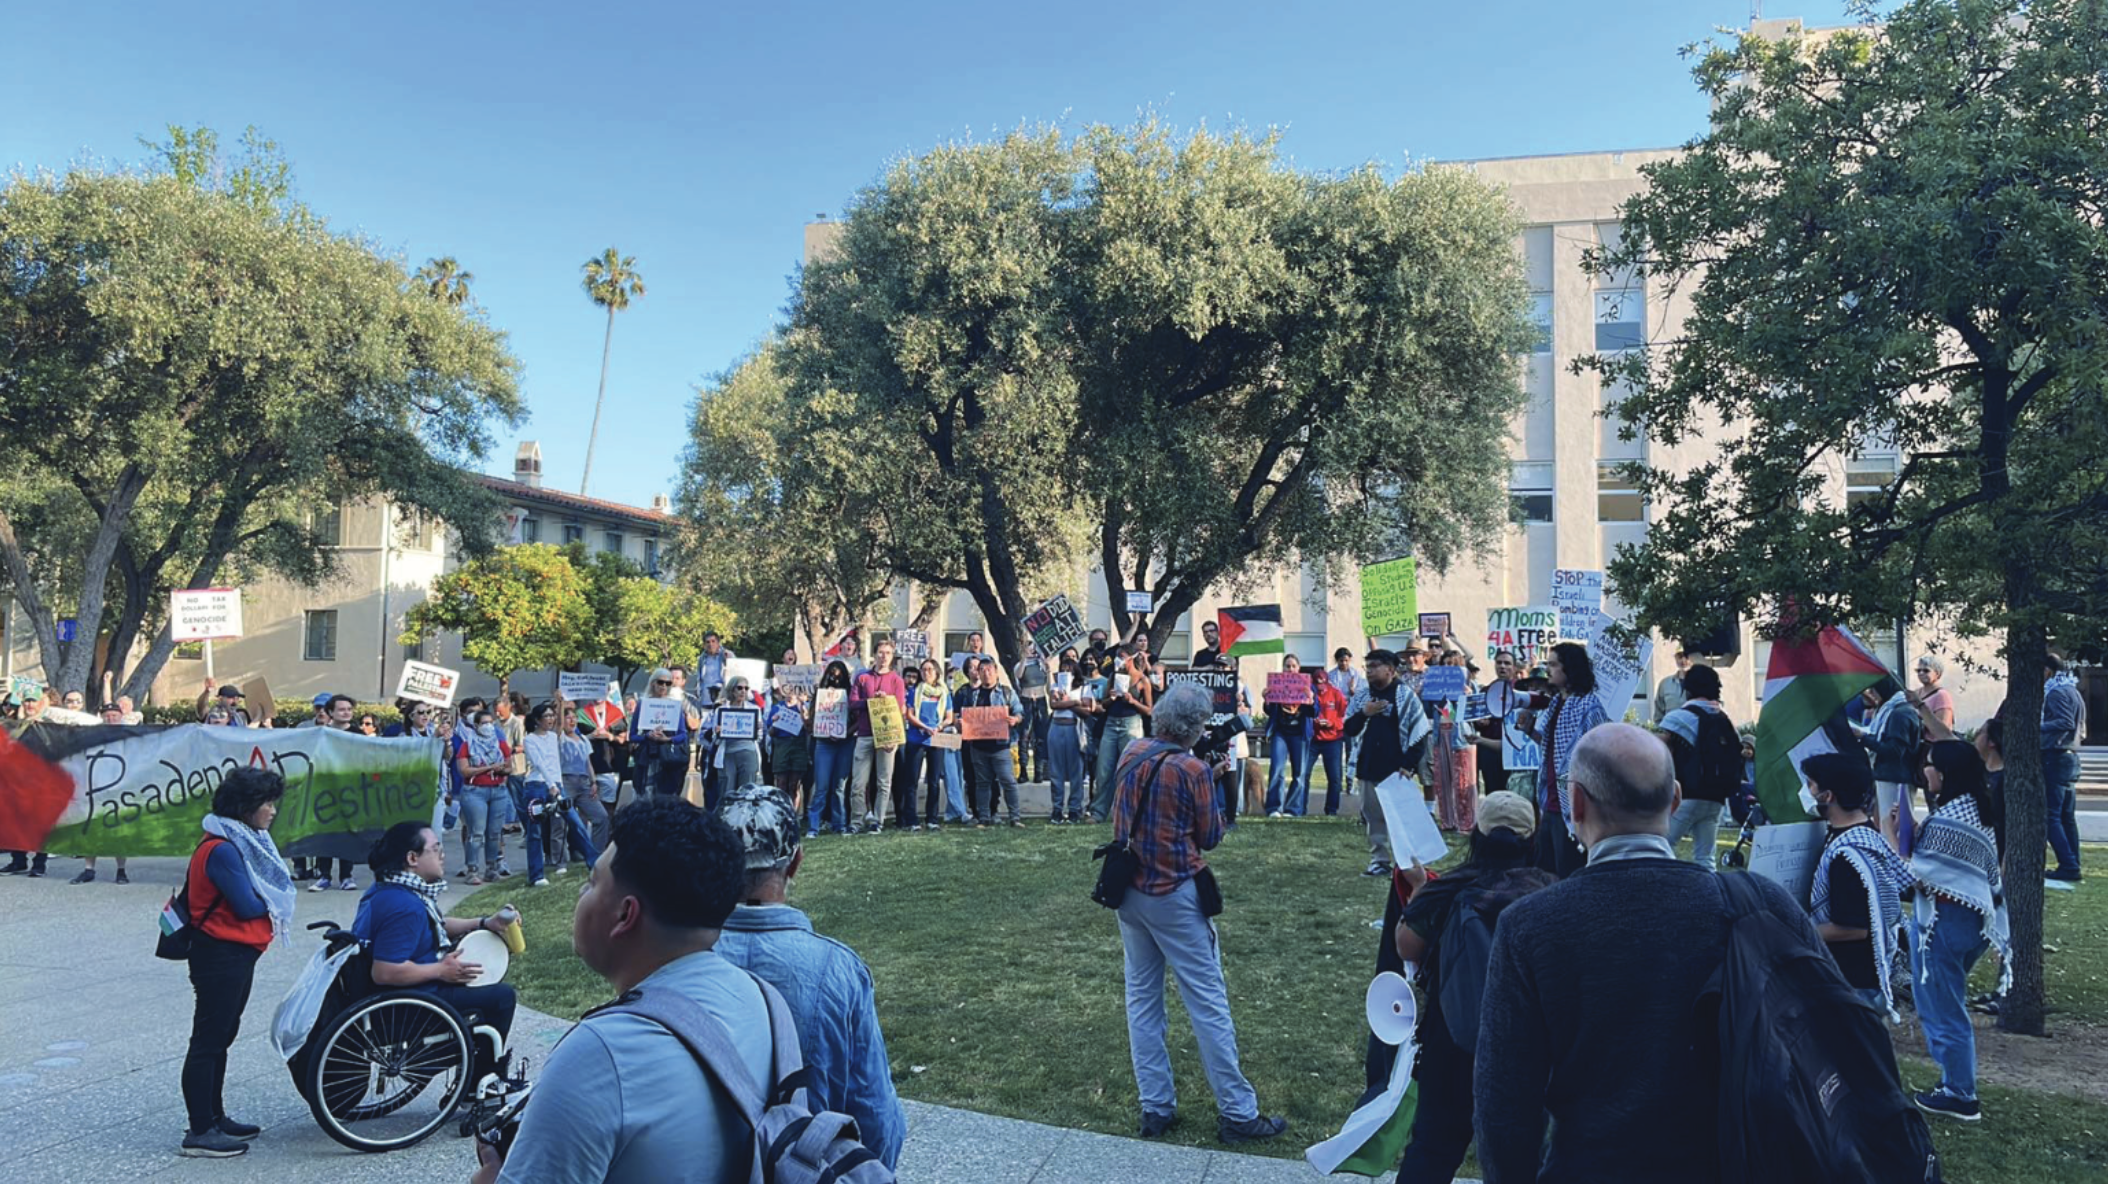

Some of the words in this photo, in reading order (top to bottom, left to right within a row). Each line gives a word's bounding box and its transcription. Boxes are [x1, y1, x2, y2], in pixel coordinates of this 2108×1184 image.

[182, 616, 227, 624] GENOCIDE
[1026, 608, 1051, 632] NO
[1488, 608, 1556, 629] Moms
[896, 629, 926, 642] FREE
[815, 722, 846, 737] HARD
